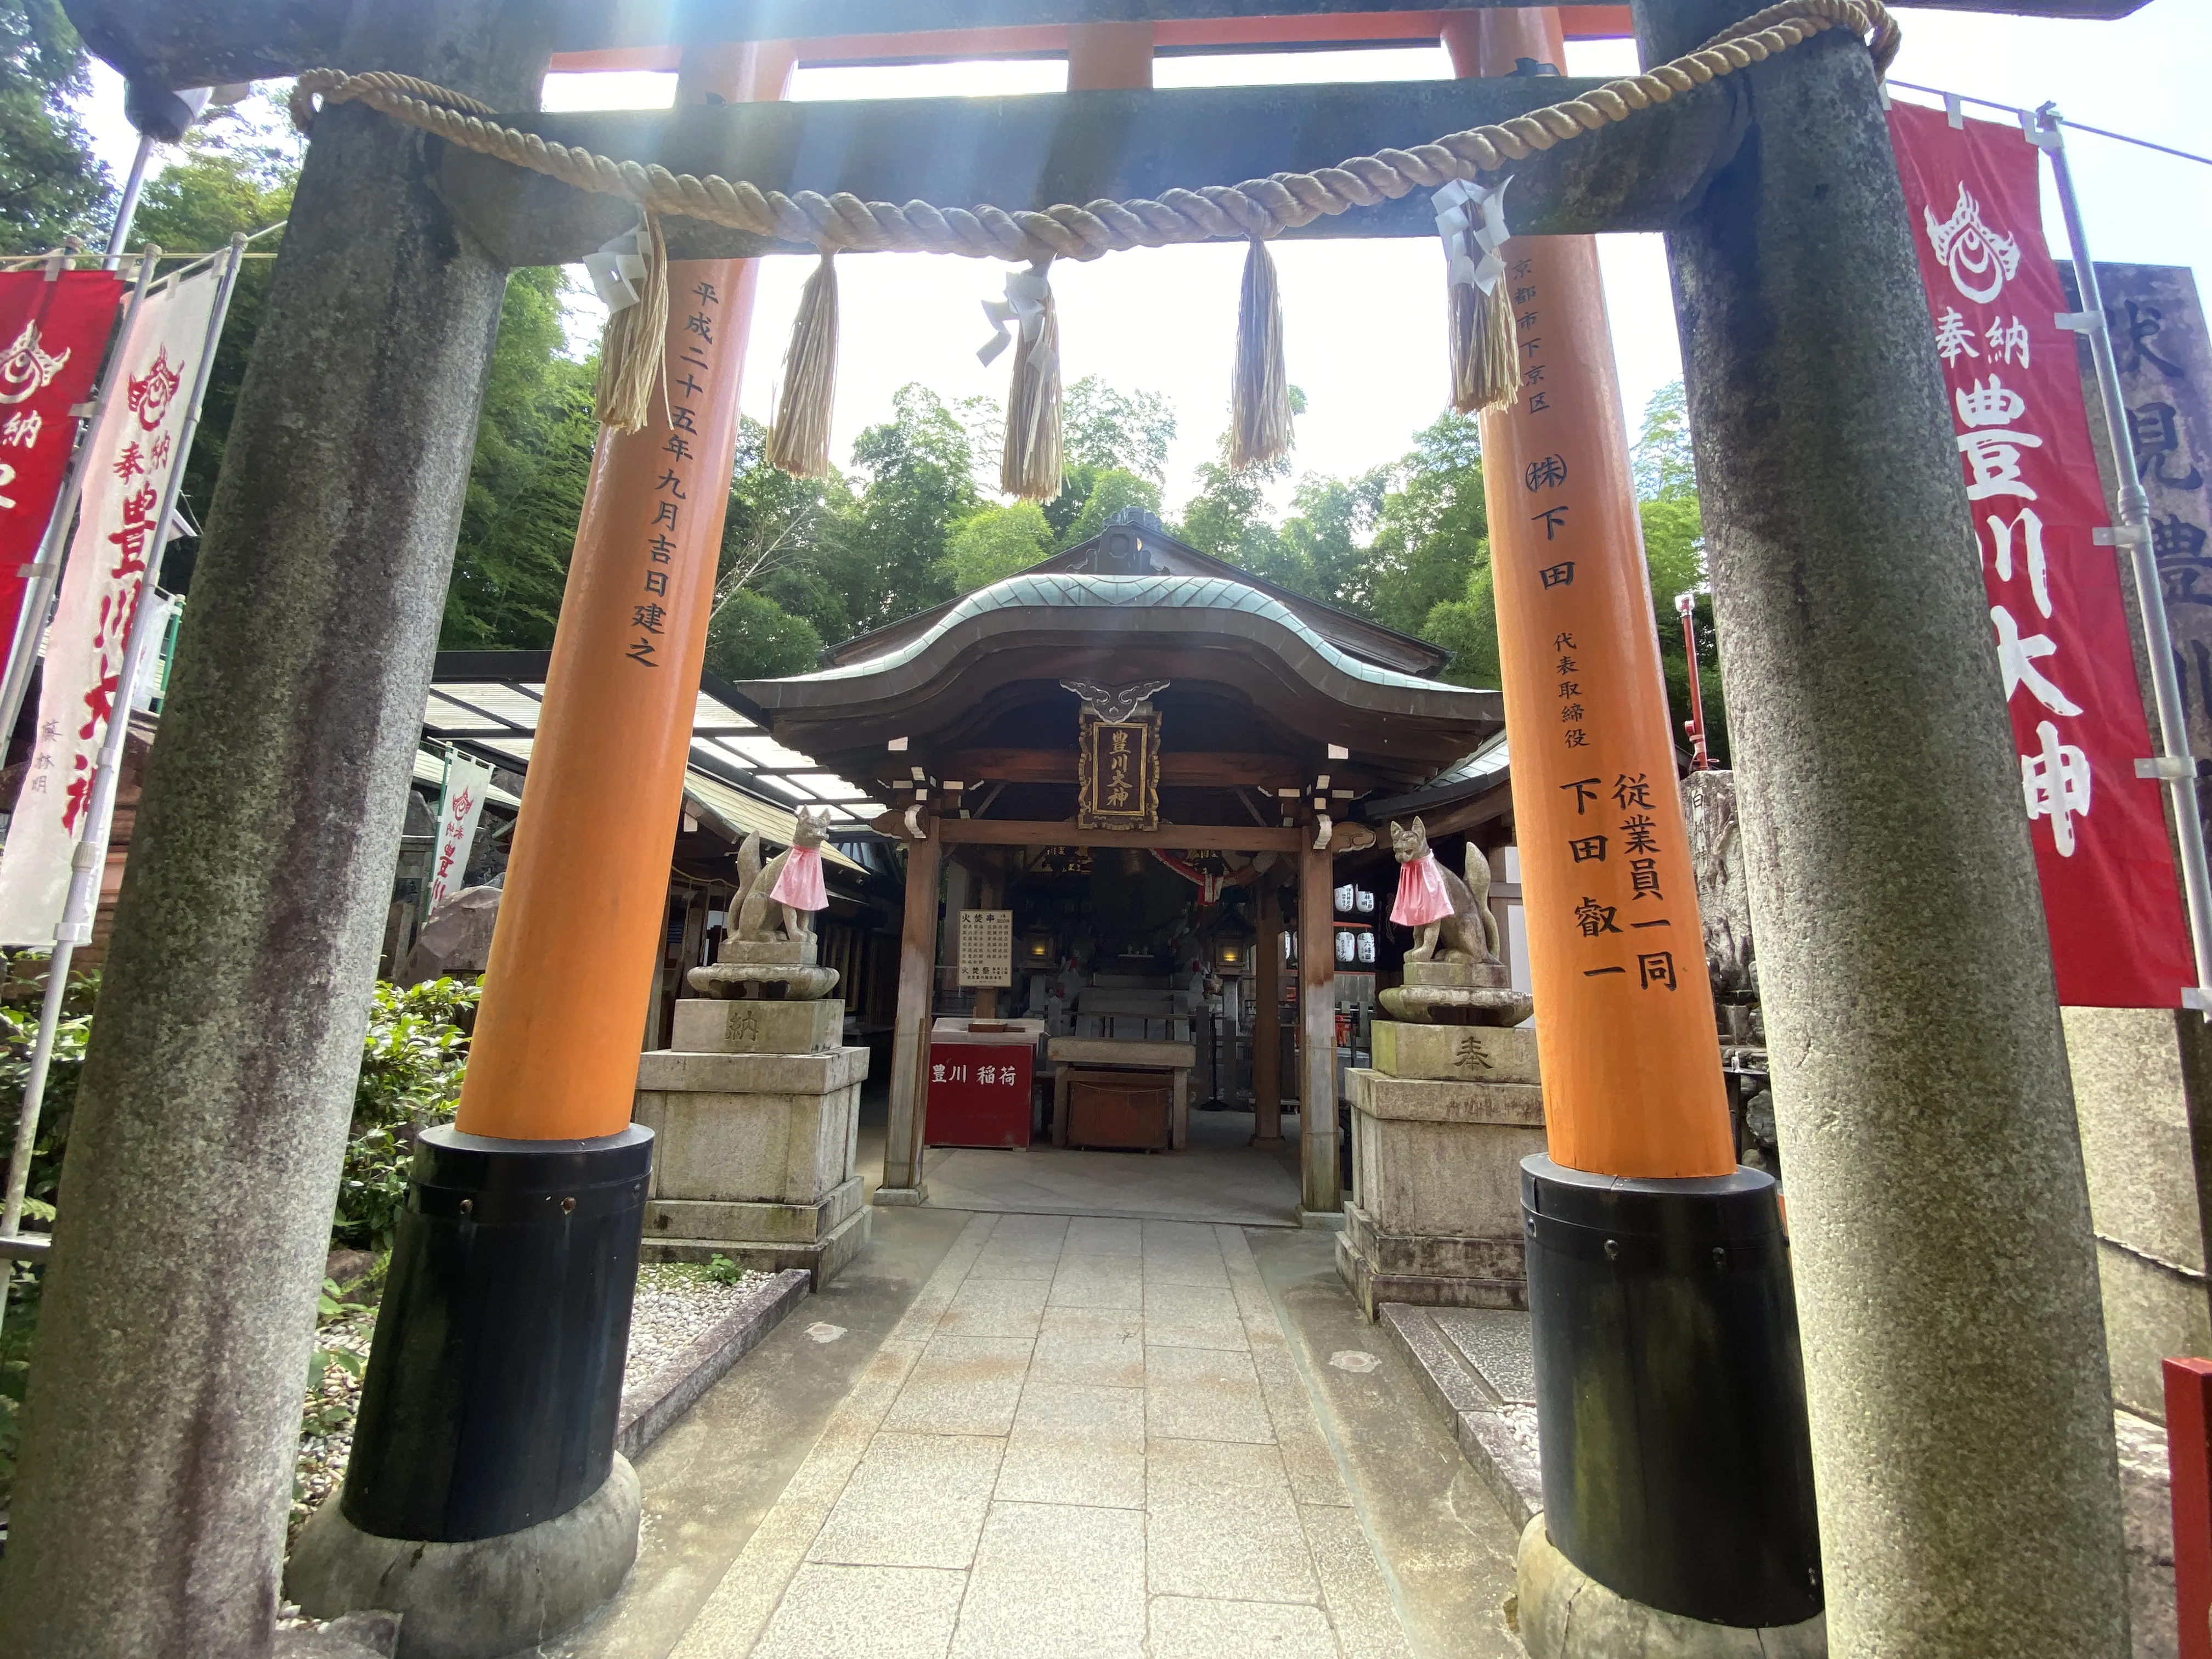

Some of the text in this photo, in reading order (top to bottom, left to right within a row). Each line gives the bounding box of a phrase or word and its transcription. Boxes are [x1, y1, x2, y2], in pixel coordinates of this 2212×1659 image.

[1511, 258, 1550, 414] 京都市下京区
[1936, 306, 2029, 369] 奉納
[114, 430, 170, 483] 奉納
[626, 281, 719, 667] 平成二十五年九月吉日建之
[1552, 631, 1590, 749] 代表取締役
[1611, 774, 1677, 992] 従業員一同
[725, 1010, 759, 1042] 納
[1453, 1036, 1494, 1071] 奉
[976, 1065, 1017, 1087] 稲荷
